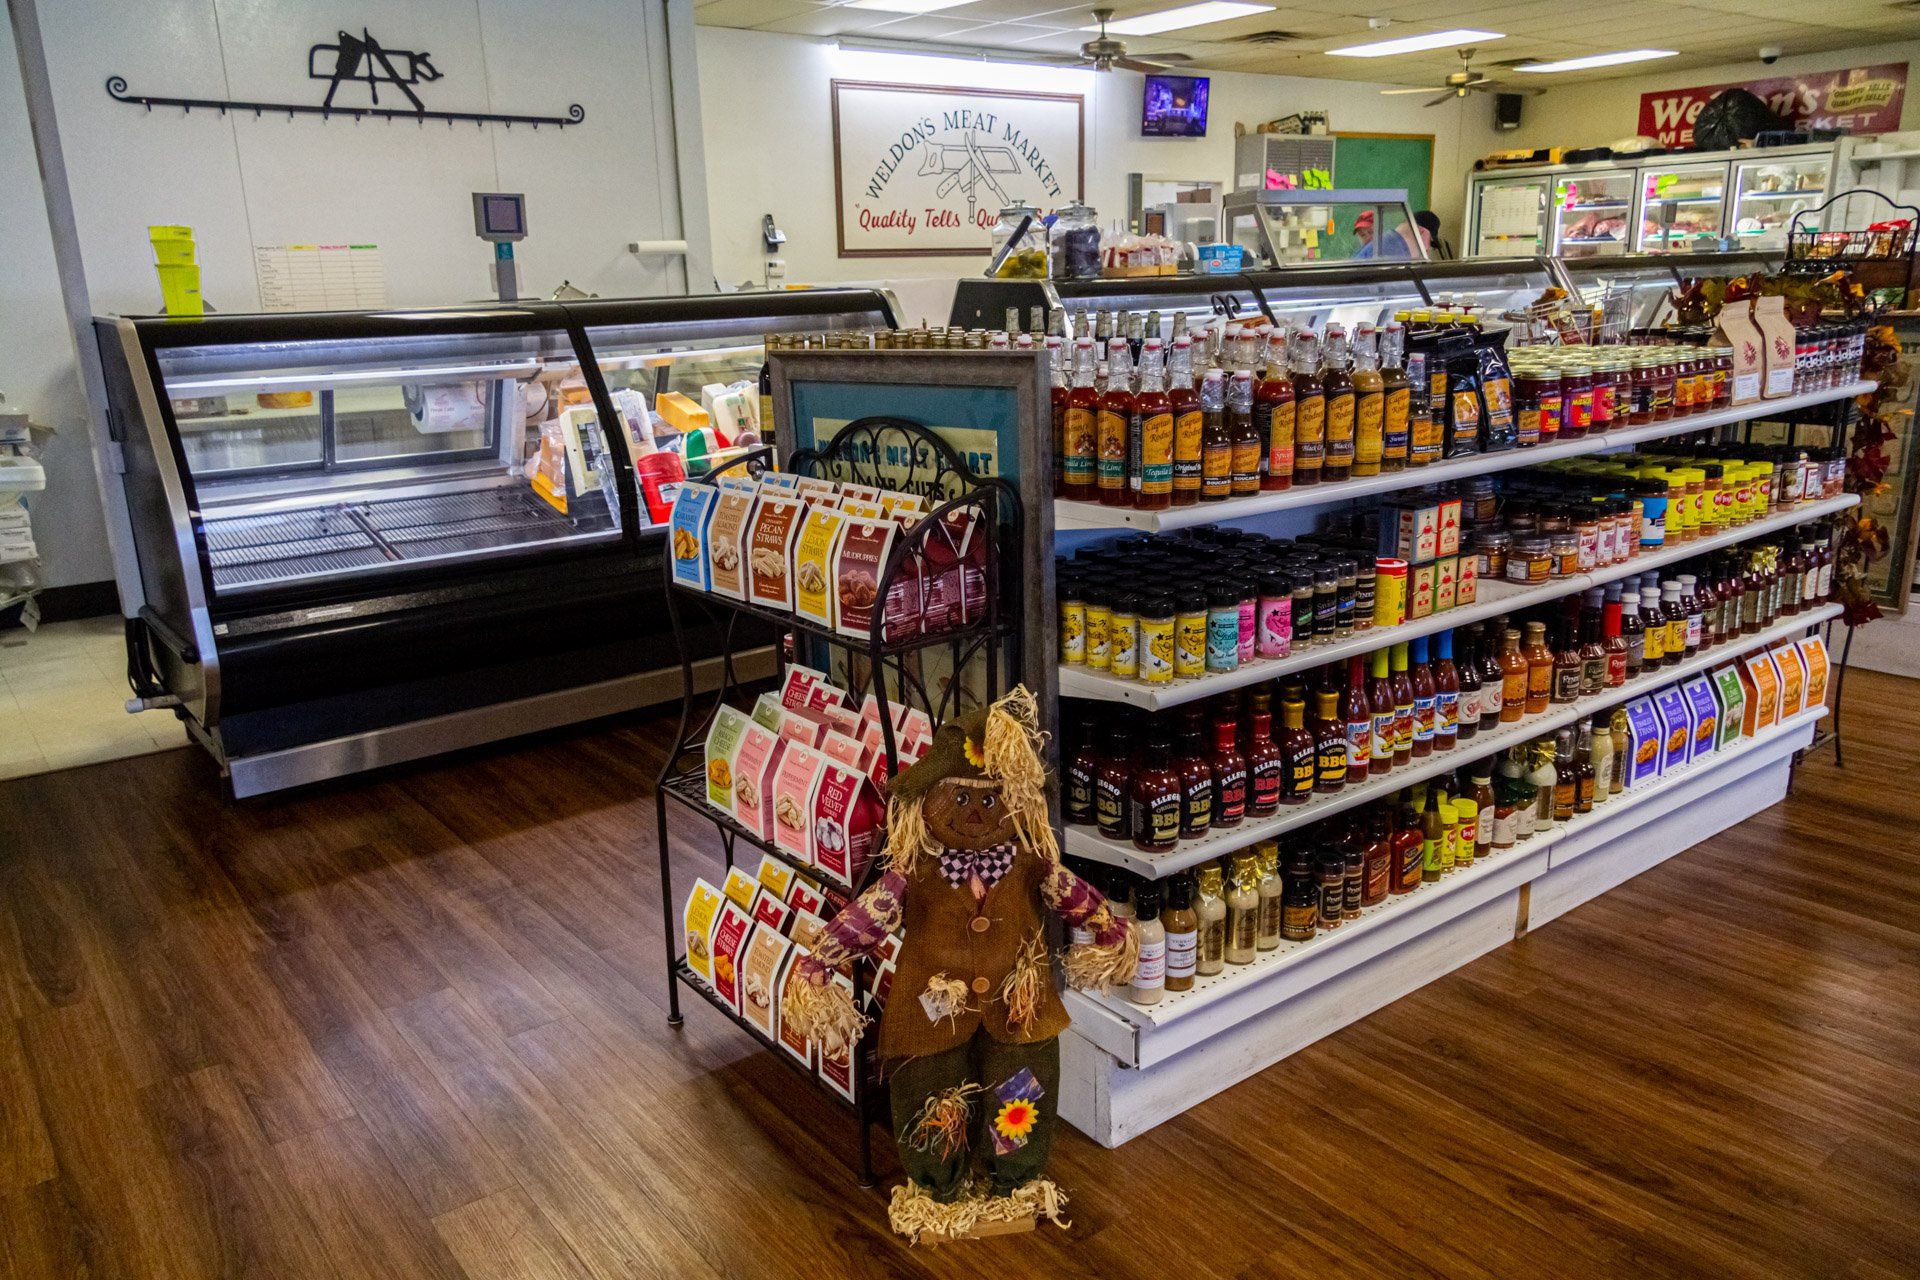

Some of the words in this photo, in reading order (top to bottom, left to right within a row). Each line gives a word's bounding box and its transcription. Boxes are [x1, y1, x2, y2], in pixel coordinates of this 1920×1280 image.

[1651, 80, 1821, 130] Wen's
[1658, 129, 1695, 145] ME
[1795, 112, 1879, 134] RKET
[865, 116, 936, 200] WELDON'S
[943, 109, 998, 134] MEAT
[1002, 122, 1062, 199] MARKET
[925, 207, 960, 228] Tells
[1106, 464, 1122, 472] Lime
[1145, 468, 1168, 479] Tequila
[719, 511, 739, 524] TOASTED
[717, 520, 738, 531] ALMOND
[759, 523, 784, 535] PECAN
[756, 532, 783, 545] STRAWS
[803, 533, 827, 547] LEMON
[801, 544, 825, 559] STRAWS
[841, 550, 879, 563] MUDPUPPIES
[1698, 703, 1713, 715] TRASH
[1669, 714, 1685, 726] TRASH
[1638, 725, 1656, 737] TRASH
[1293, 746, 1315, 763] ALLEG
[1318, 754, 1347, 768] BBQ
[1221, 770, 1247, 787] ALLEG
[1293, 763, 1314, 779] BB
[827, 785, 843, 801] RED
[1188, 779, 1212, 797] ALLEG
[821, 794, 844, 813] VELVET
[1189, 799, 1211, 814] BB
[720, 929, 738, 948] CHEESE
[716, 936, 735, 958] STRAWS
